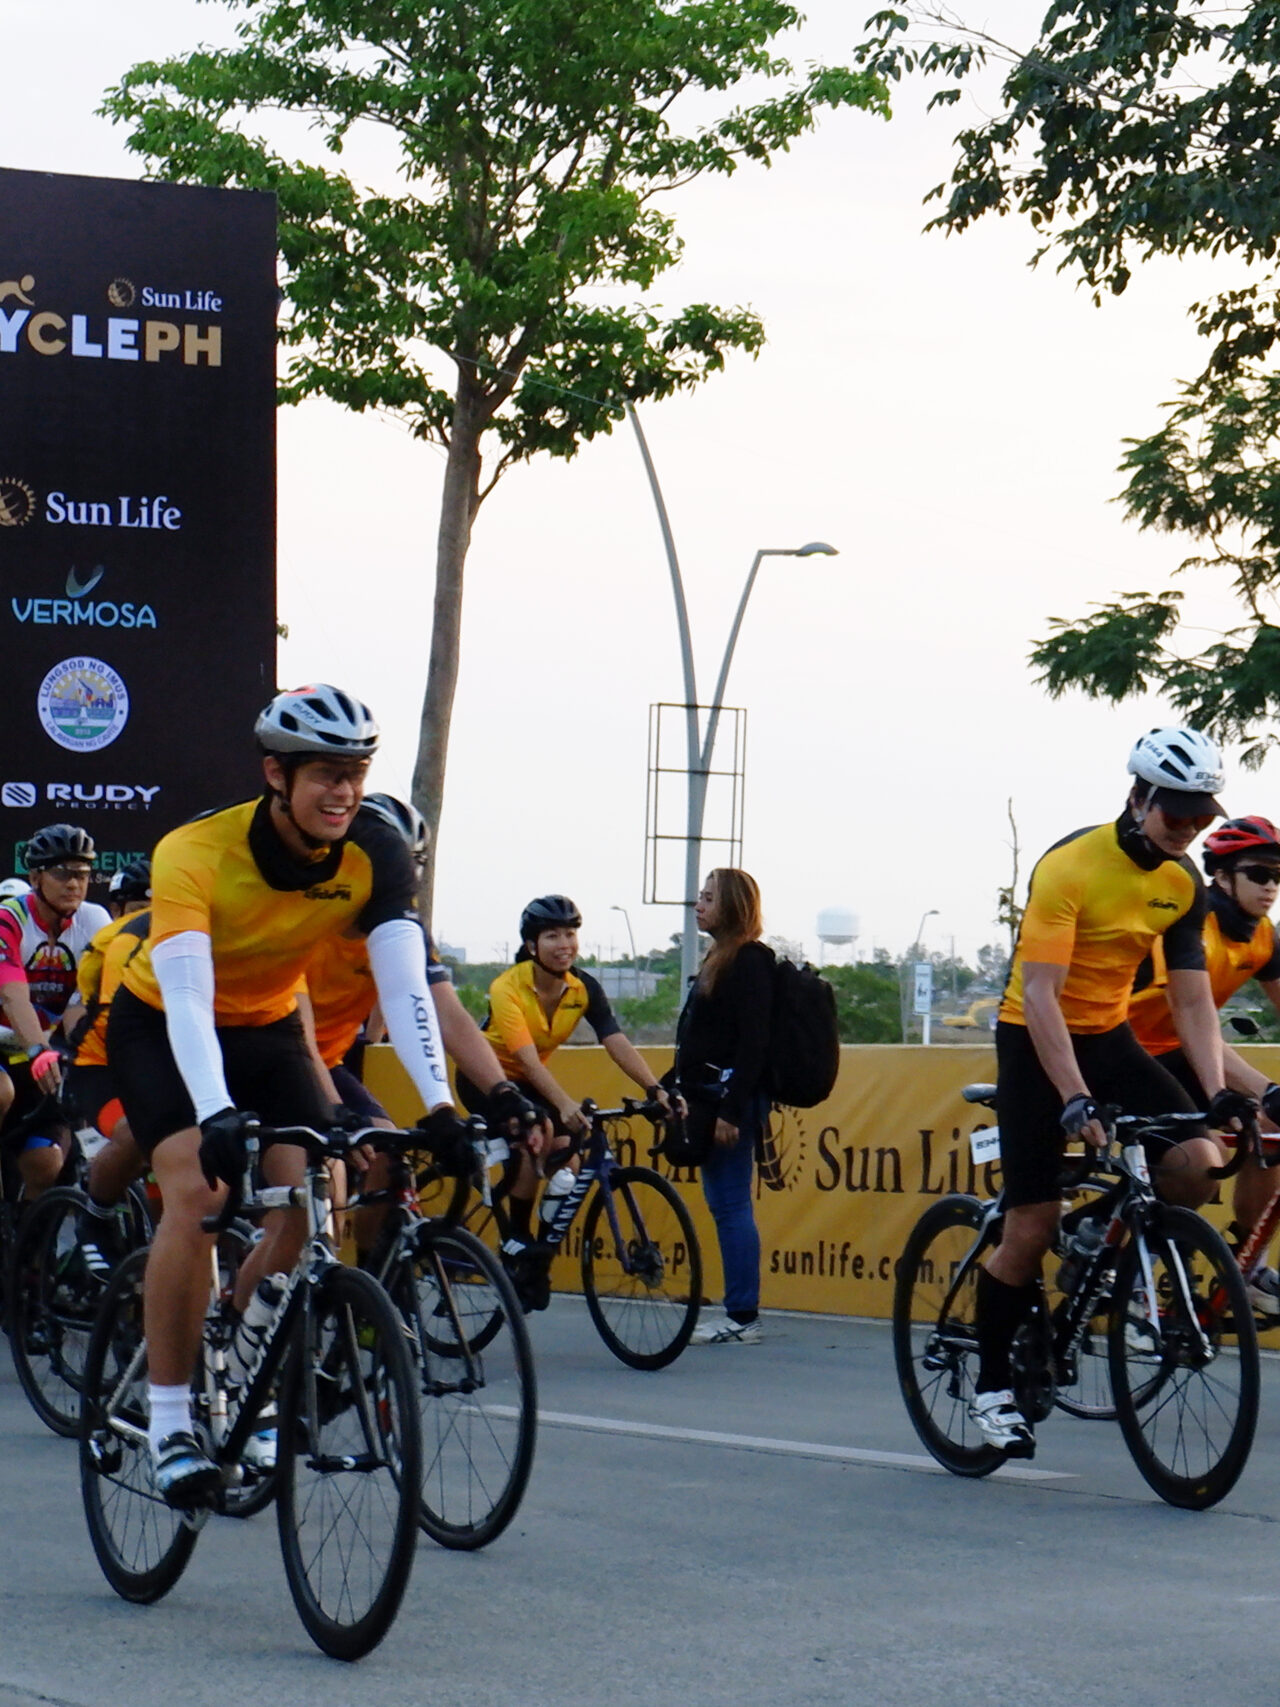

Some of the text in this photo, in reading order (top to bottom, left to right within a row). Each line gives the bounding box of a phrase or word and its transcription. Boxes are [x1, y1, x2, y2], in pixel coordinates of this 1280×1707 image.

[141, 286, 222, 312] Sun Life
[45, 491, 181, 530] Sun Life
[11, 597, 157, 629] VERMOSA
[41, 660, 85, 698] LUNGSOD
[106, 671, 126, 700] IMUS
[47, 783, 161, 802] RUDY
[55, 801, 151, 810] PROJECT
[409, 993, 436, 1059] RUDY
[815, 1126, 905, 1193] Sun
[547, 1168, 597, 1243] CANYON
